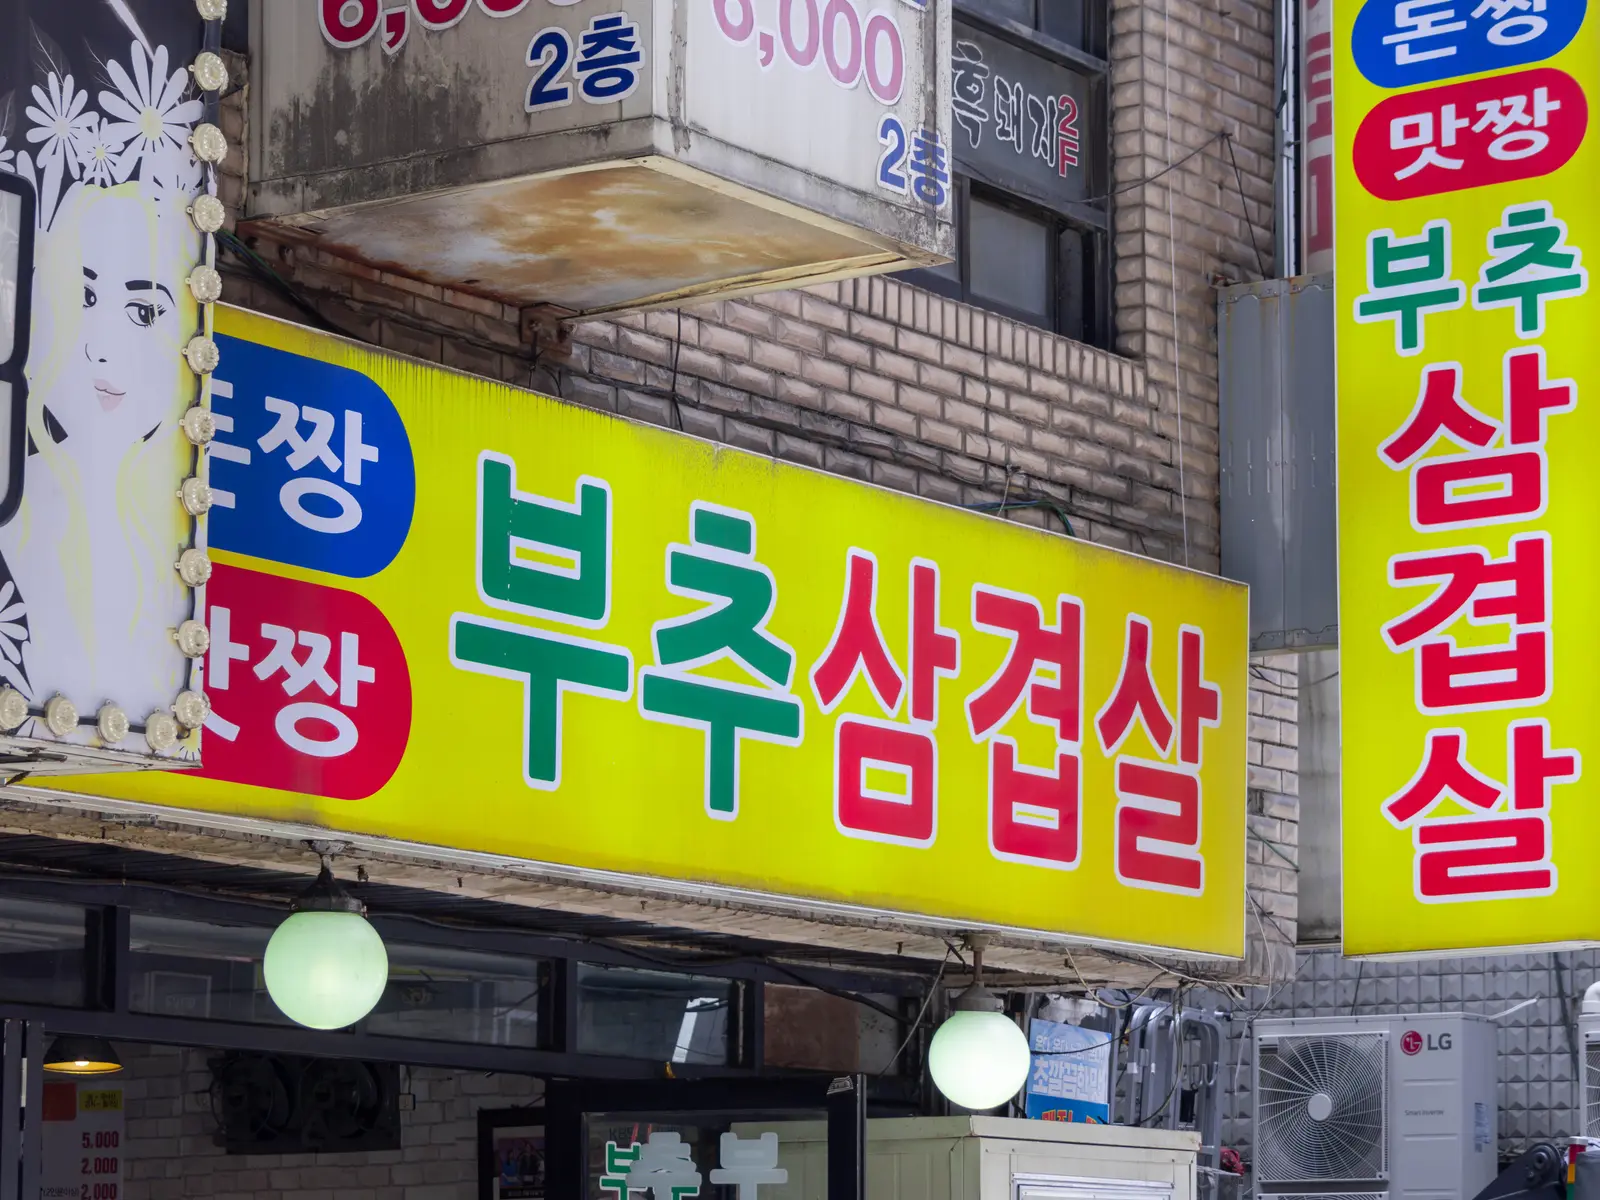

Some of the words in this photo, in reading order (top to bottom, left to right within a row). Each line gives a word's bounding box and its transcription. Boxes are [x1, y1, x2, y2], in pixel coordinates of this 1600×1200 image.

[524, 11, 645, 113] 2층
[877, 113, 951, 207] 2층
[1058, 94, 1079, 178] 2F
[1389, 86, 1561, 181] 맛짱
[1353, 200, 1589, 357] 부추
[1377, 345, 1581, 904] 삼겹살
[1427, 1033, 1452, 1051] LG
[81, 1157, 118, 1174] 2,000
